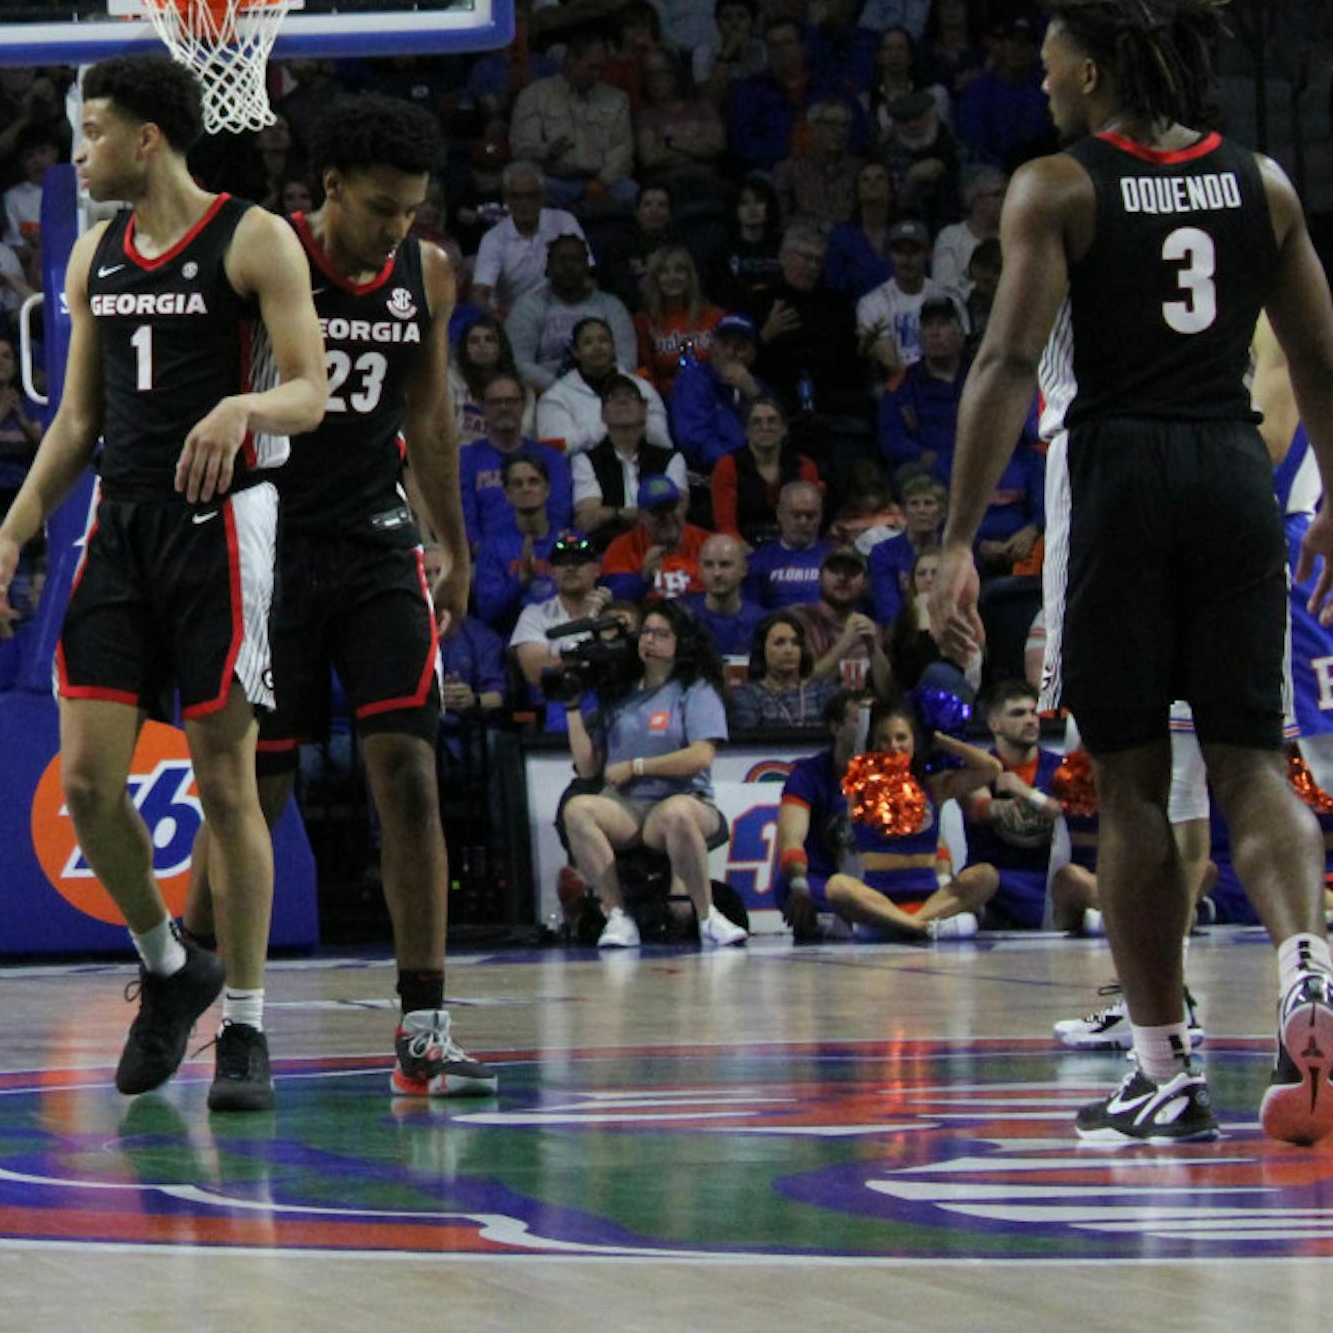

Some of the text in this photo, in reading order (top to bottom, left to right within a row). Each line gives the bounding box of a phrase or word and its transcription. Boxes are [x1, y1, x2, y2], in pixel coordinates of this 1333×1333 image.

[1119, 172, 1242, 215] OQUENDO
[1162, 226, 1217, 335] 3
[90, 292, 208, 316] GEORGIA
[318, 317, 421, 343] EORGIA
[131, 325, 153, 391] 1
[324, 349, 388, 413] 23
[769, 567, 821, 582] FLORID
